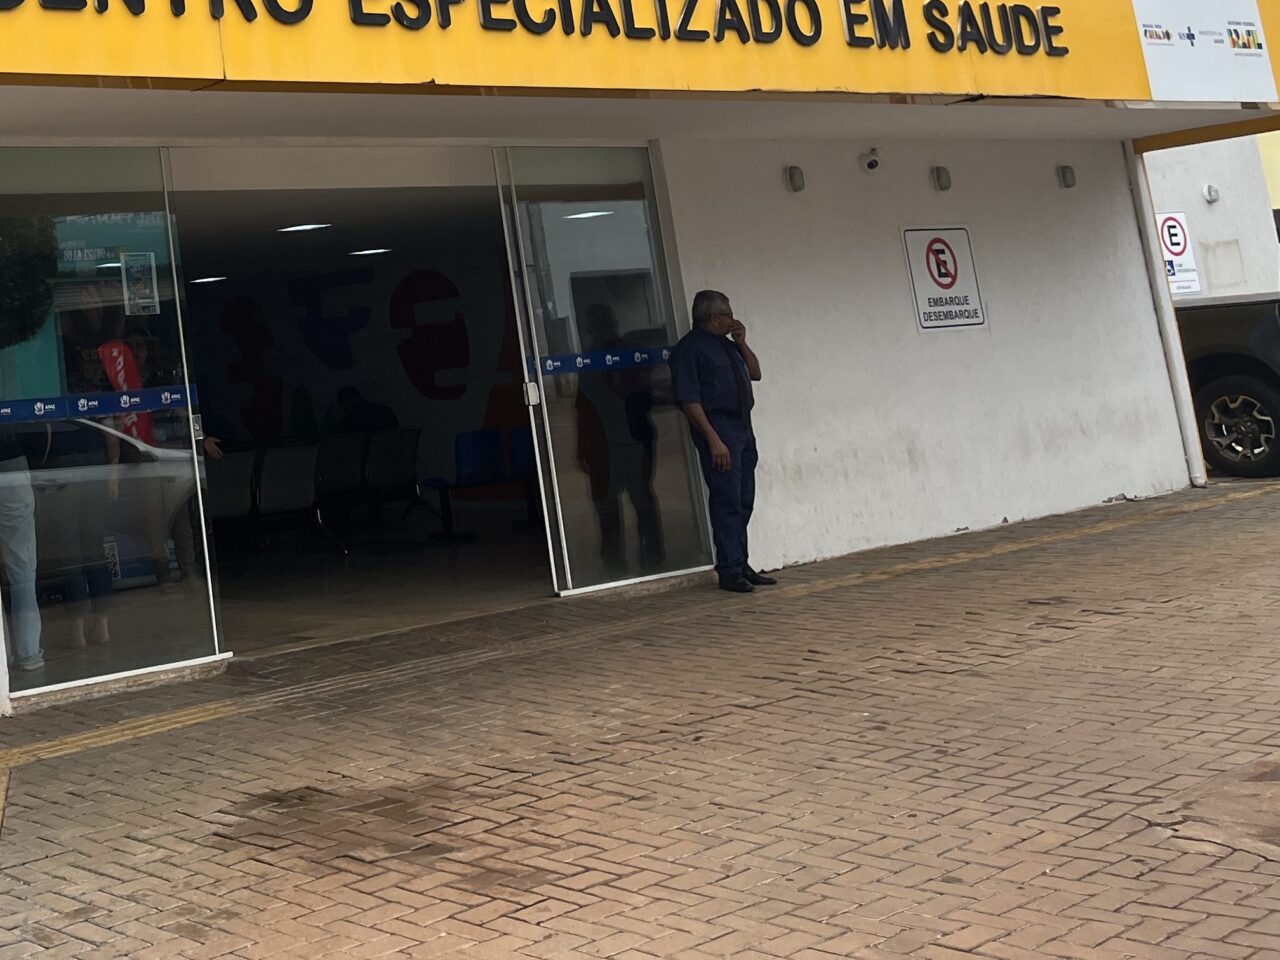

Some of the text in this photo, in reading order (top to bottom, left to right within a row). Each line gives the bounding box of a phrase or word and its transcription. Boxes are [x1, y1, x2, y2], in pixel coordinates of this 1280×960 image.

[1167, 225, 1181, 246] E
[928, 296, 970, 307] EMBARQUE
[923, 309, 979, 321] DESEMBARQUE
